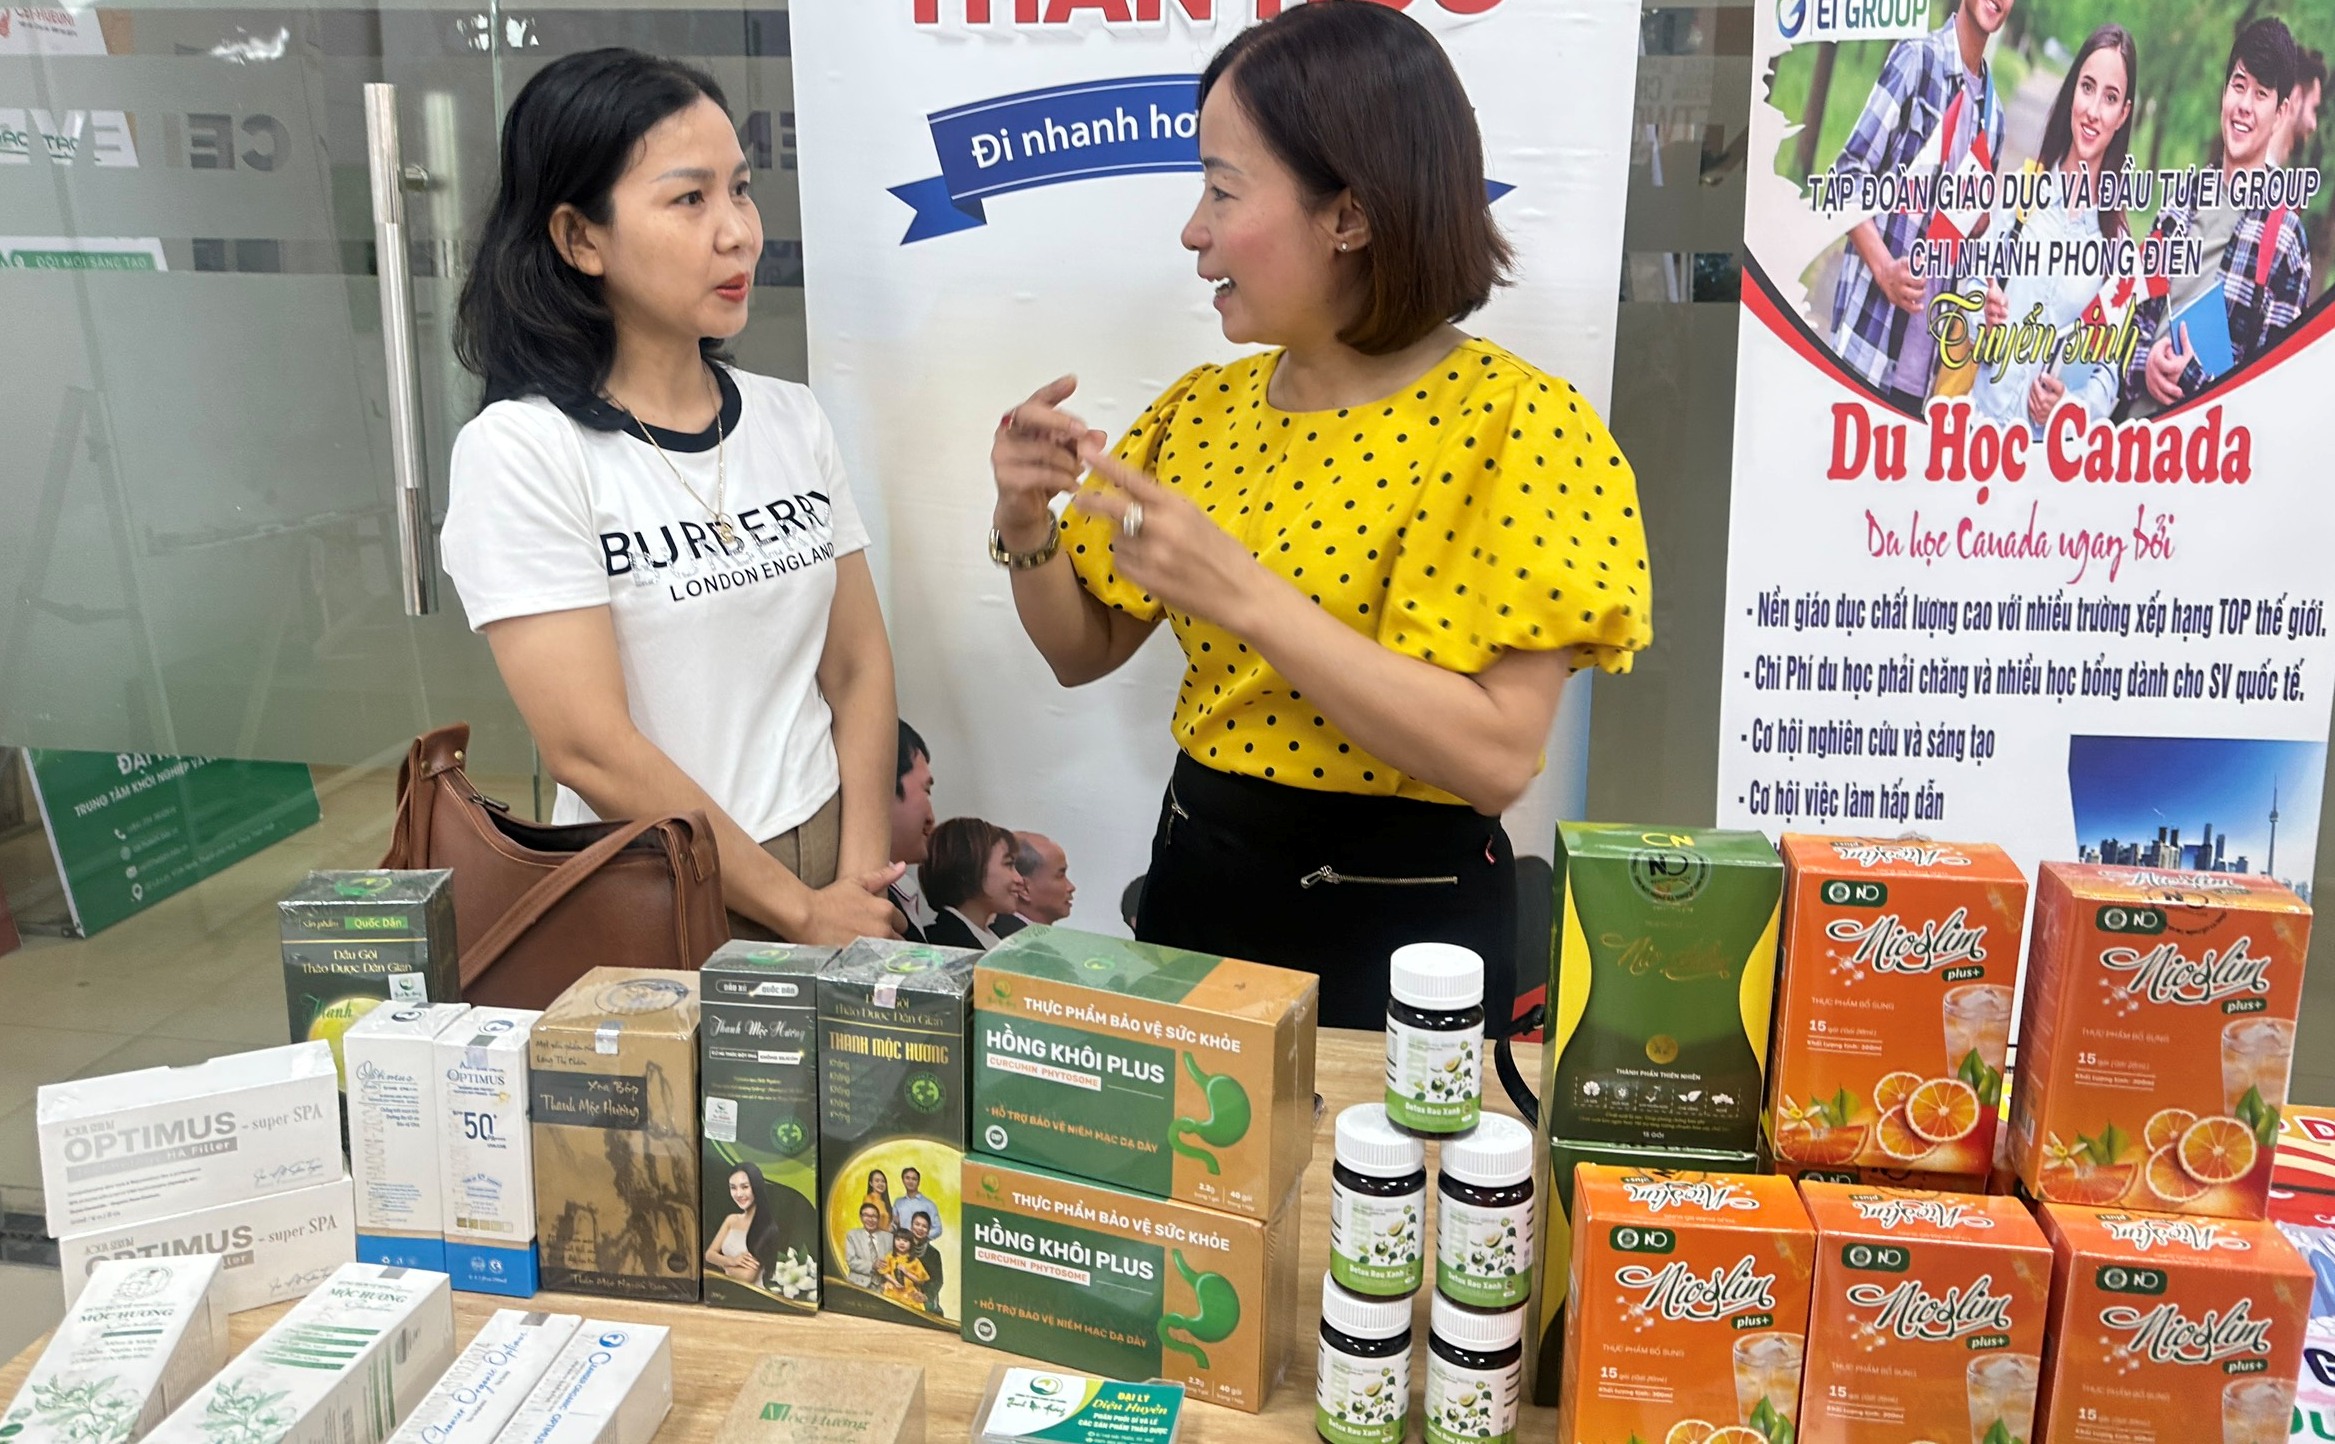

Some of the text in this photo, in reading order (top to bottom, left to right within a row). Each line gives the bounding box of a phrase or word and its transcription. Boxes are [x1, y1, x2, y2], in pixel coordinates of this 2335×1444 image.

[1817, 0, 1927, 29] EI GROUP
[971, 103, 1199, 168] Đi nhanh hơ
[1809, 157, 2318, 219] TẬP ĐOÀN GIÁO DỤC VÀ ĐẦU TƯ EI GROUP
[1910, 225, 2203, 277] CHI NHÁNH PHONG ĐIỀN
[1927, 291, 2141, 384] Tuyển sinh
[1827, 402, 2252, 505] Du Học Canada
[1865, 500, 2174, 585] Du học Canada ngay bởi
[670, 542, 835, 602] LONDON ENGLAND
[1757, 585, 2327, 642] Nền giáo dục chất lượng cao với nhiều trường xếp hạng TOP thế giới.
[1755, 652, 2305, 704] Chi Phí du học phải chăng và nhiều học bổng dành cho SV quốc tế.
[1752, 717, 1995, 766] Cơ hội nghiên cứu và sáng tạo
[1749, 777, 1944, 824] Cơ hội việc làm hấp dẫn
[1947, 967, 1981, 981] plus+
[1023, 997, 1241, 1053] THỰC PHẨM BẢO VỆ SỨC KHỎE
[1809, 1020, 1827, 1032] 15
[2227, 1000, 2263, 1013] plus+
[828, 1031, 949, 1064] THANH MỘC HƯƠNG
[986, 1022, 1165, 1084] HỒNG KHÔI PLUS
[2078, 1052, 2096, 1064] 15
[989, 1057, 1099, 1087] CURCUMIN PHYTOSOME
[540, 1094, 576, 1113] Thanh
[578, 1098, 600, 1116] Mộc
[64, 1103, 323, 1163] OPTIMUS super SPA
[1012, 1192, 1230, 1251] THỰC PHẨM BẢO VỆ SỨC KHỎE
[974, 1216, 1154, 1280] HỒNG KHÔI PLUS
[977, 1250, 1087, 1282] CURCUMIN PHYTOSOME
[1736, 1316, 1770, 1329] plus+
[1971, 1336, 2006, 1349] plus+
[1600, 1366, 1618, 1378] 15
[2228, 1360, 2265, 1373] plus+
[1829, 1385, 1847, 1397] 15
[2078, 1408, 2097, 1420] 15
